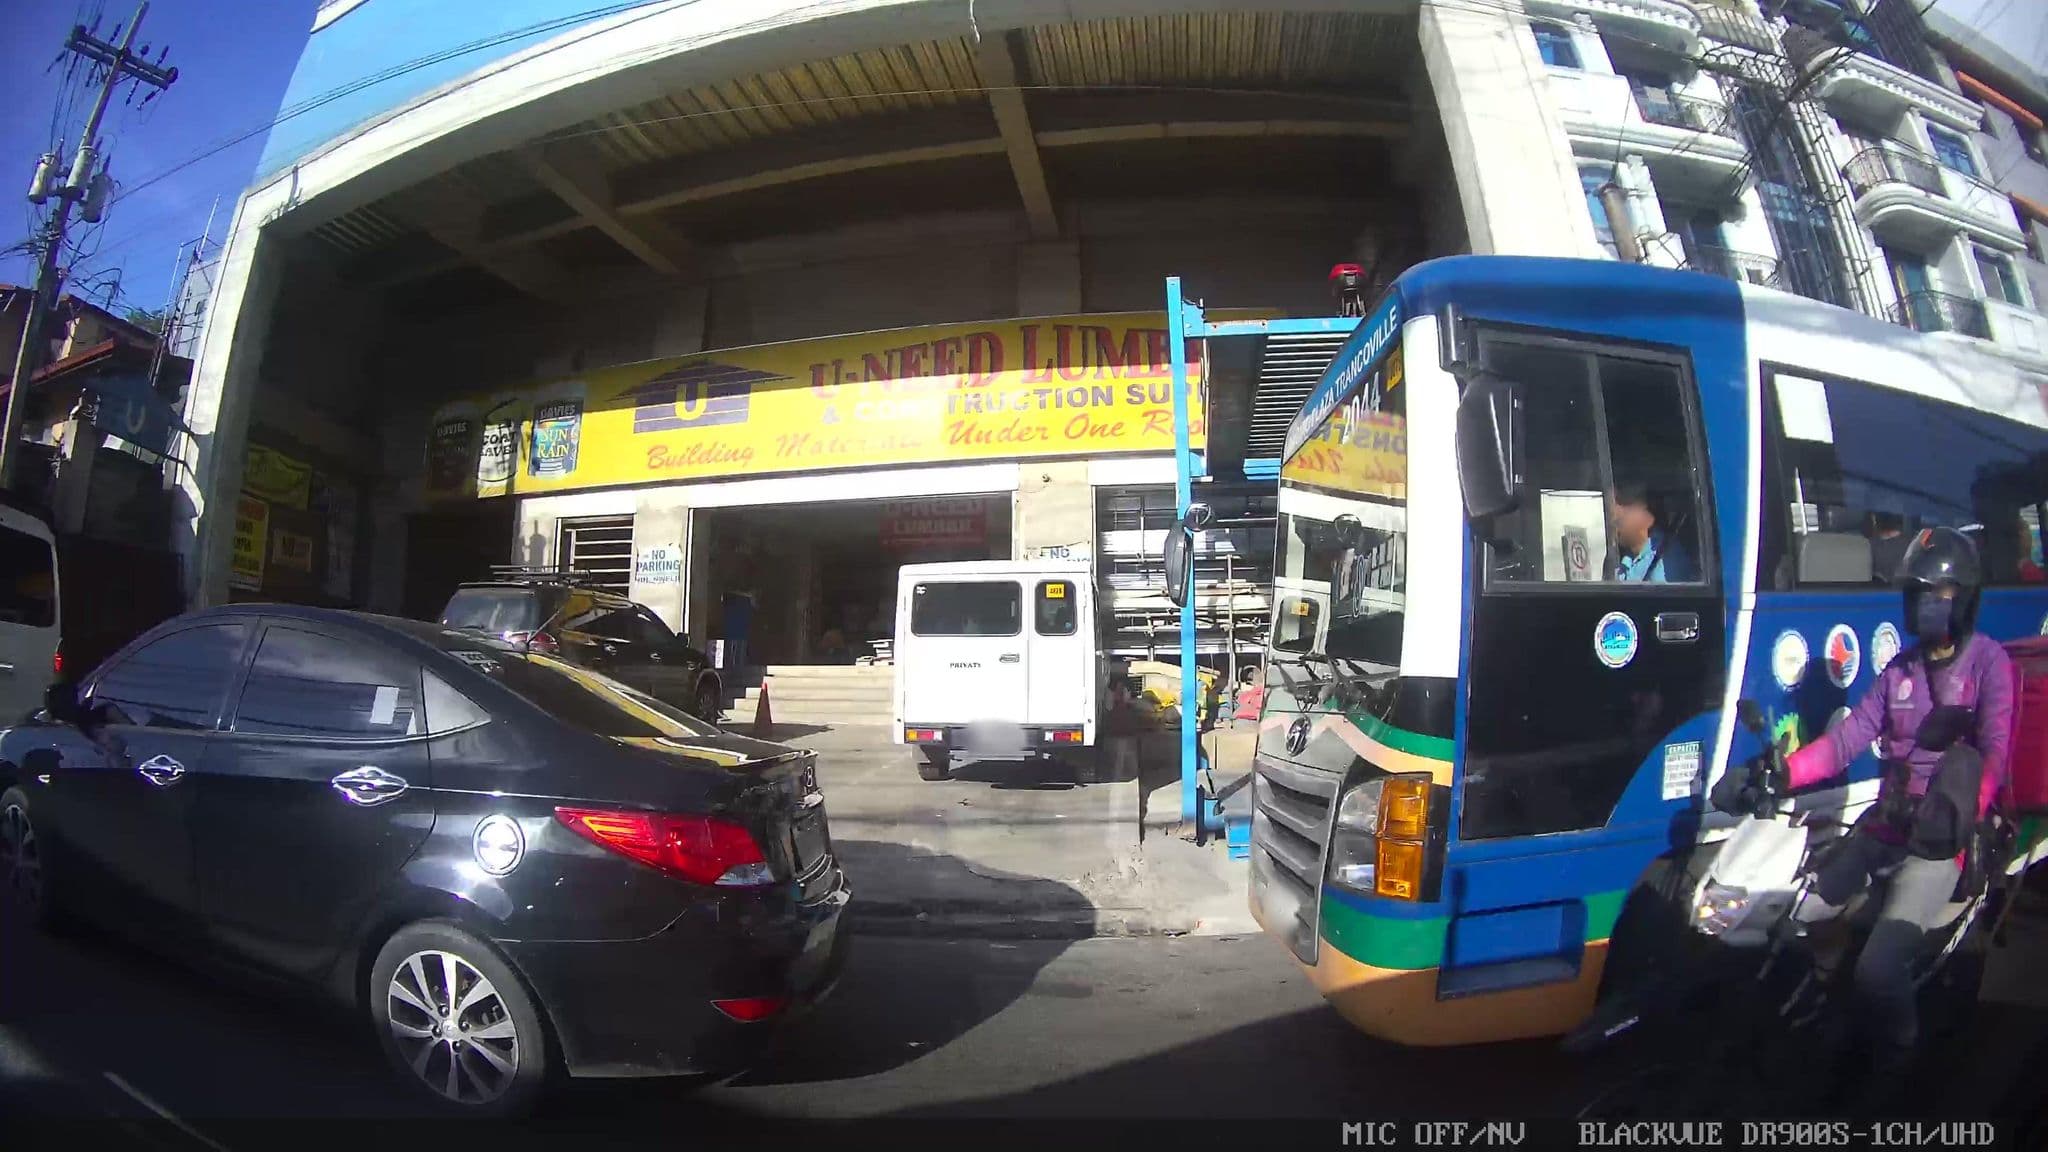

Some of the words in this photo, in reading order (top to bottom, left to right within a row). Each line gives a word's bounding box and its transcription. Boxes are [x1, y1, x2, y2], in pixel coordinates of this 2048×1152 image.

[809, 331, 1005, 399] U-NEED
[1335, 305, 1398, 397] TRANCOVILLE
[674, 382, 709, 422] U
[854, 386, 1114, 421] COTRUCTION
[1126, 382, 1202, 406] SU
[537, 442, 570, 459] RAIN
[541, 428, 568, 444] SUN
[646, 439, 755, 471] Building
[946, 419, 1050, 446] Under
[1064, 412, 1126, 440] One
[636, 559, 681, 573] PARKING
[651, 549, 666, 561] NO
